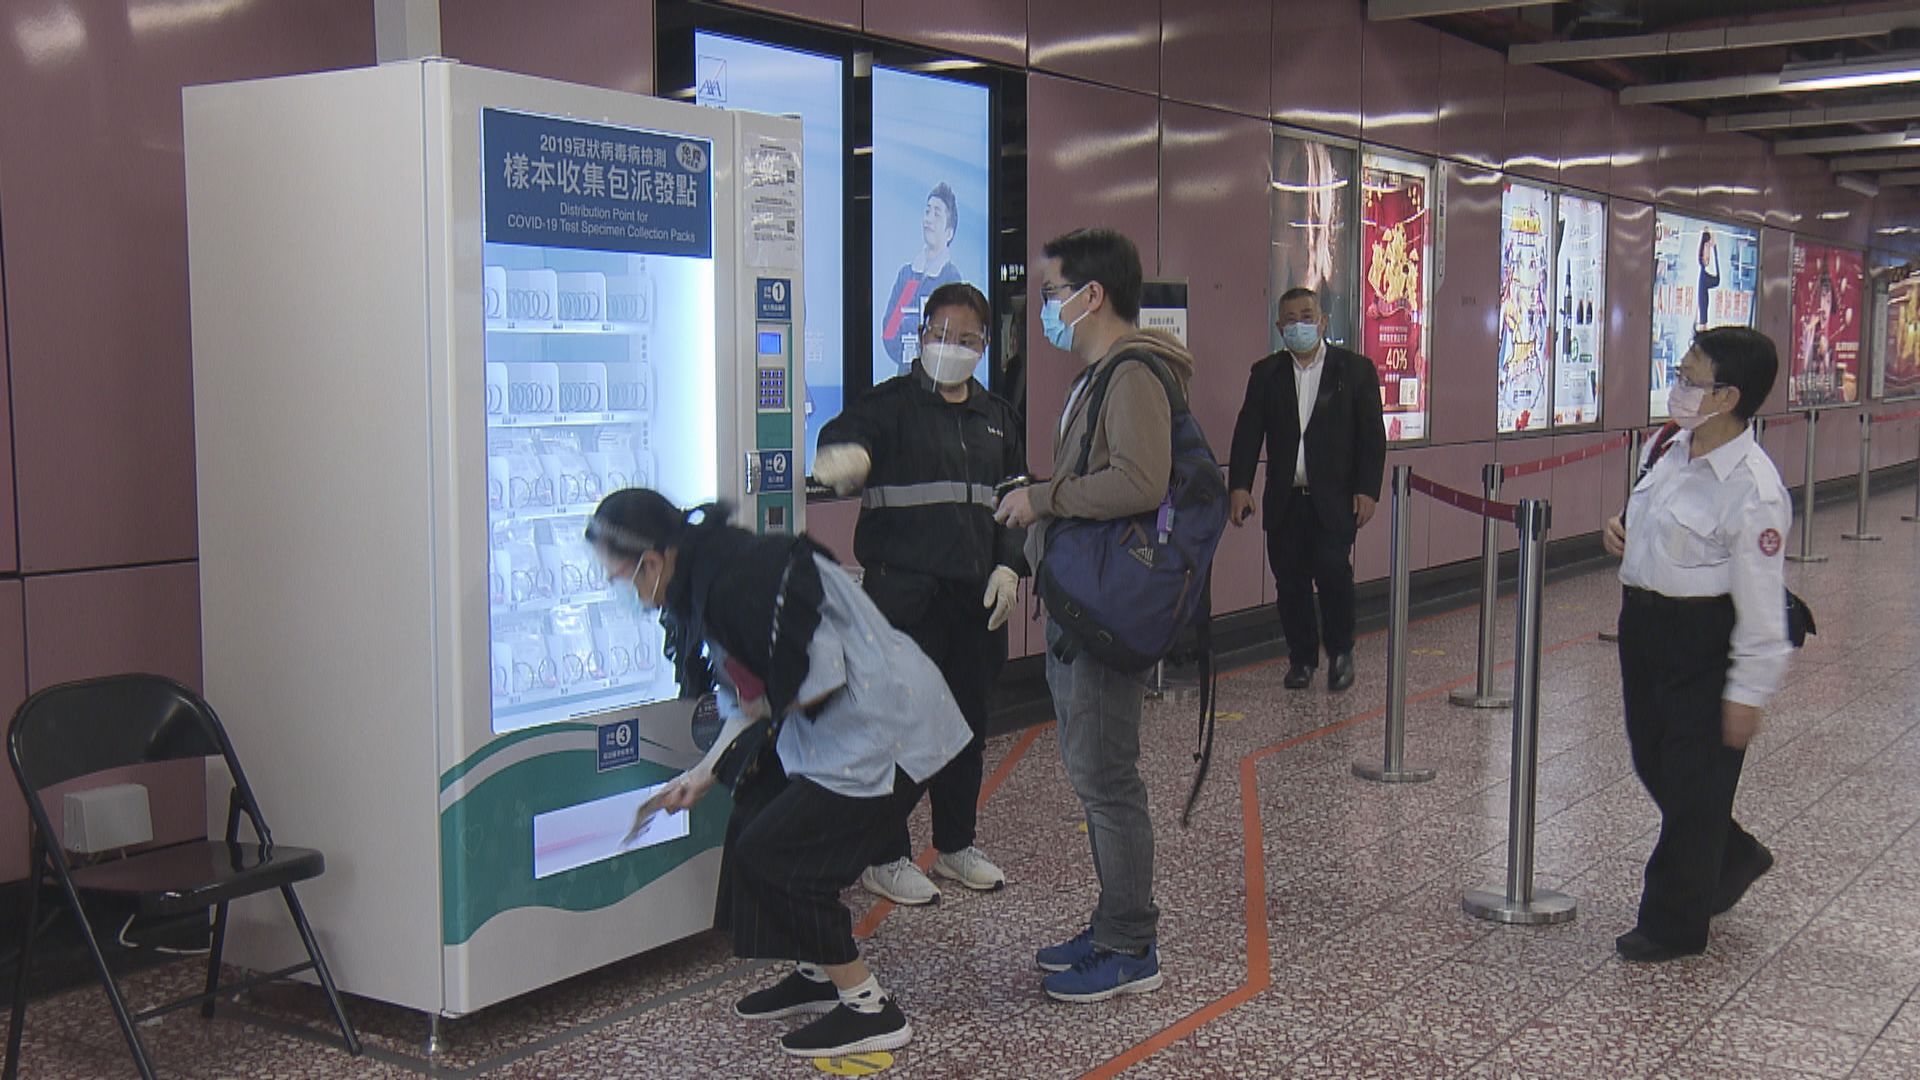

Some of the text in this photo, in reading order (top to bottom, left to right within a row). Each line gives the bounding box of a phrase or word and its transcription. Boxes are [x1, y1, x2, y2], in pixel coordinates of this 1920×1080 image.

[699, 79, 722, 97] AXA
[540, 134, 667, 169] 2019冠狀病毒病檢測
[504, 152, 697, 208] 樣本收集包派發點
[560, 202, 649, 223] Distribution Point for
[508, 214, 696, 243] COVID-19 Test Specimen Collection Packs
[1386, 347, 1408, 370] 40%
